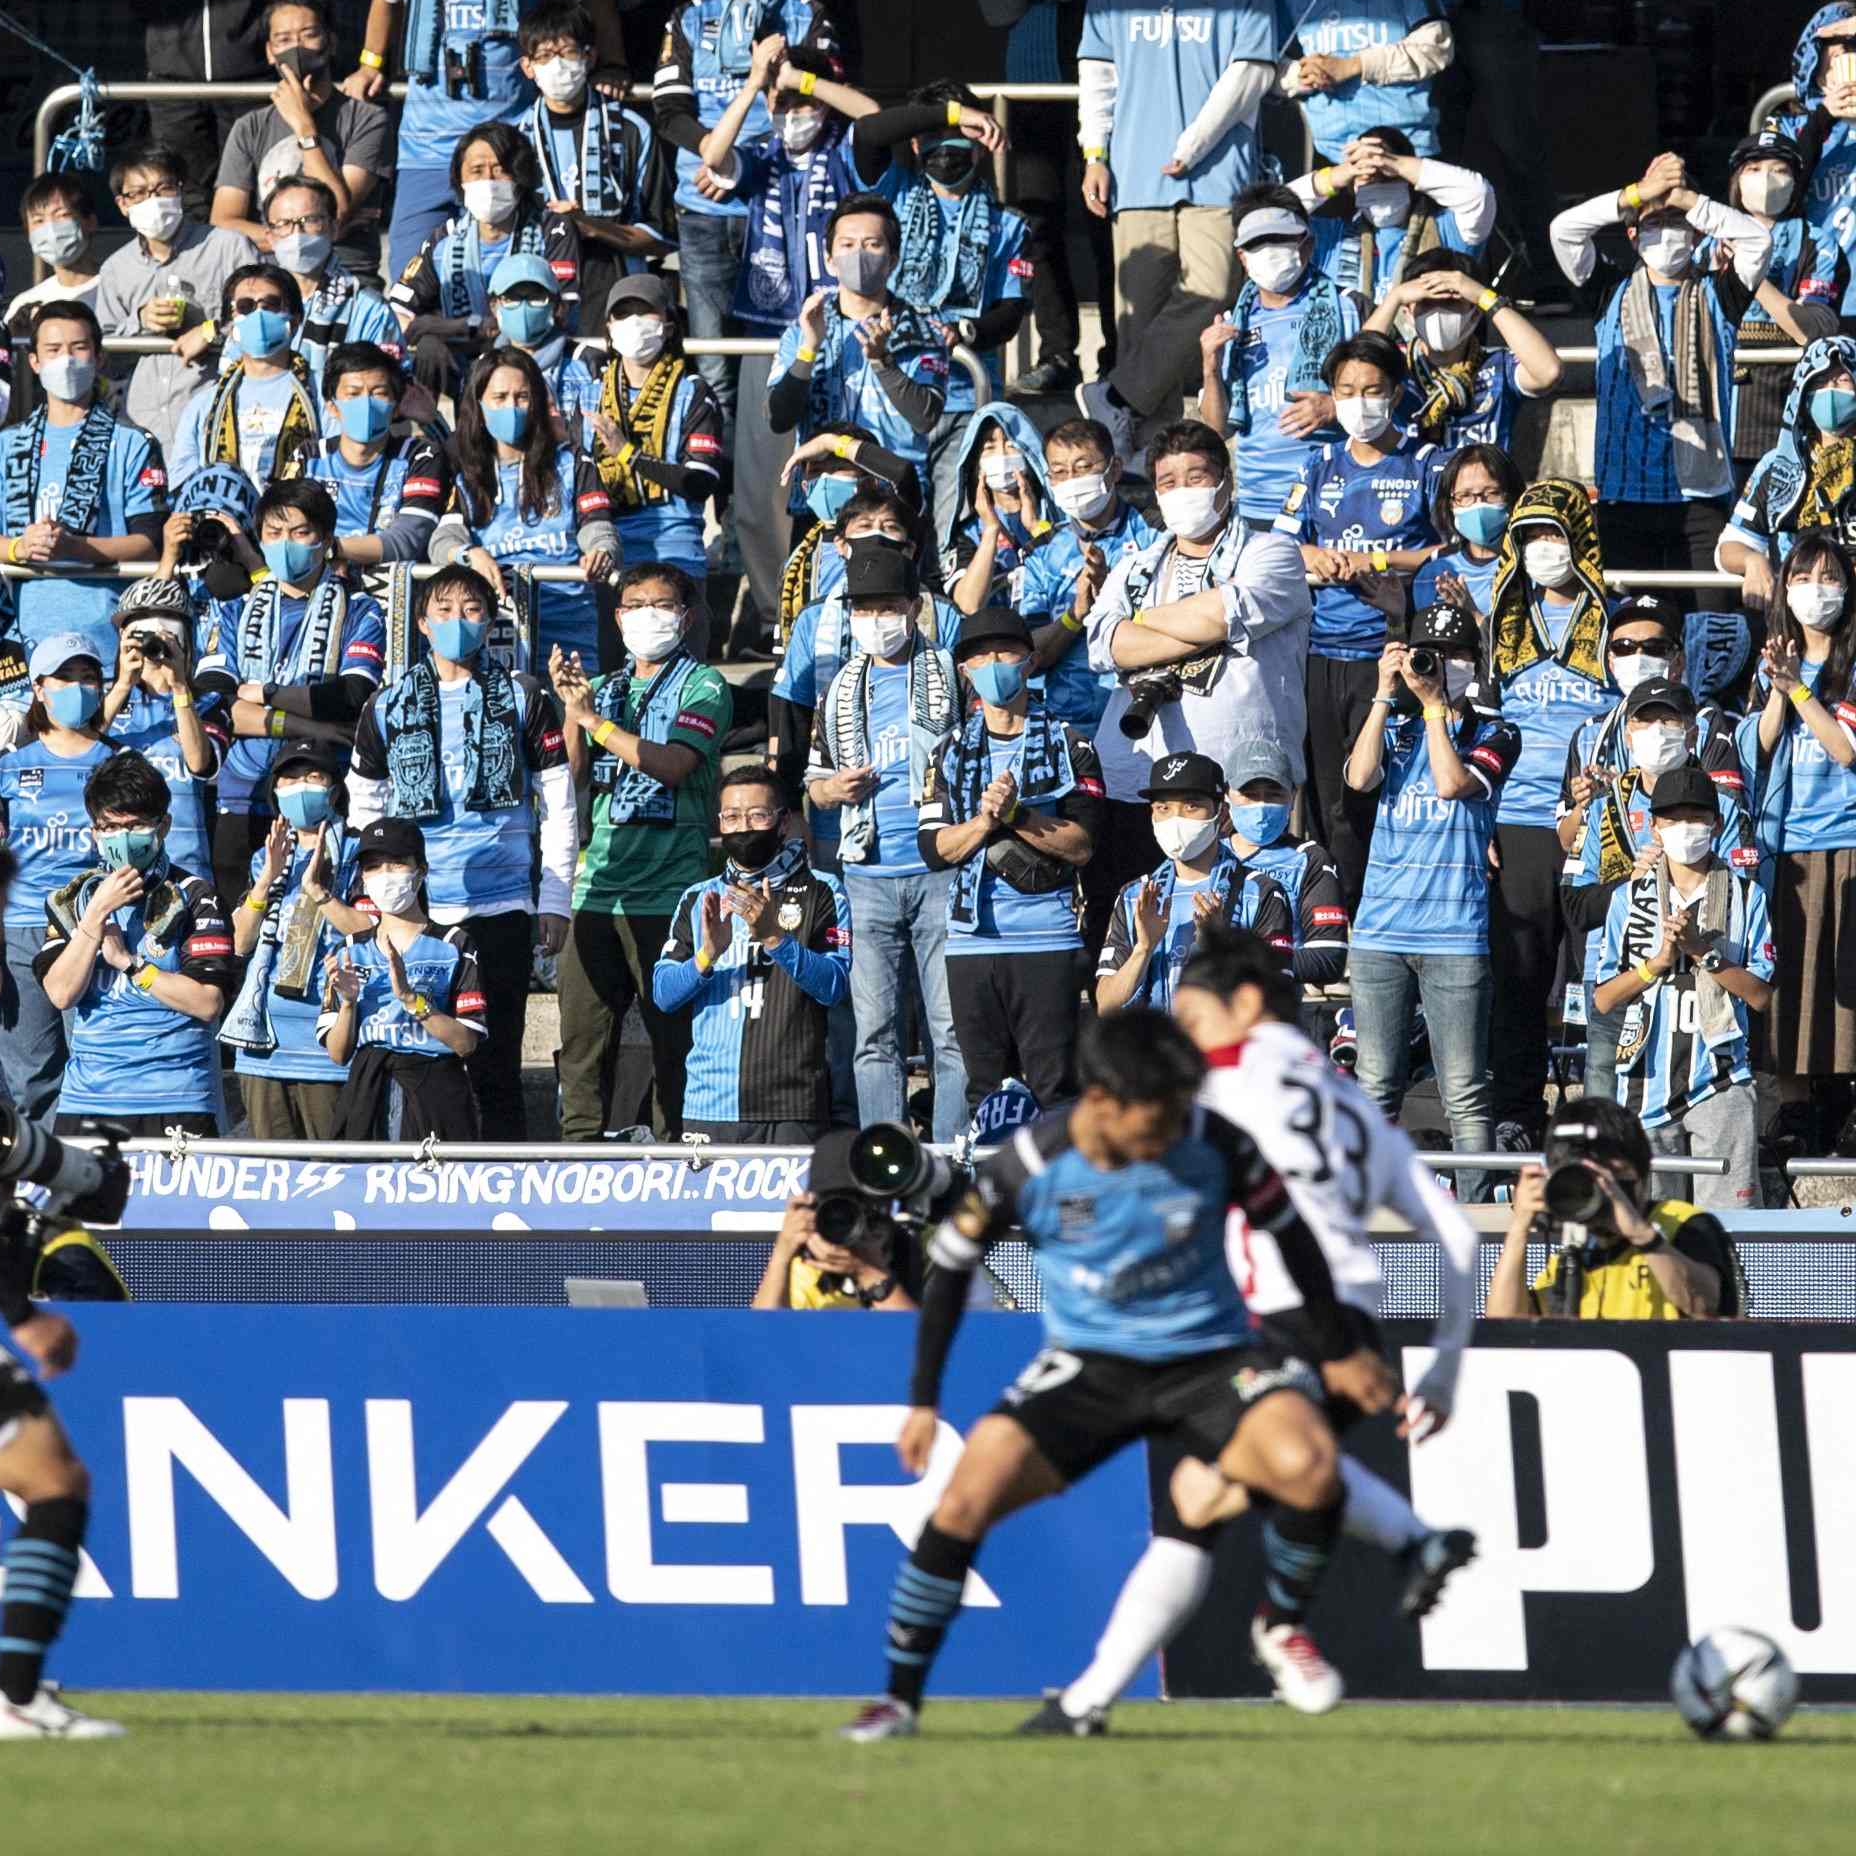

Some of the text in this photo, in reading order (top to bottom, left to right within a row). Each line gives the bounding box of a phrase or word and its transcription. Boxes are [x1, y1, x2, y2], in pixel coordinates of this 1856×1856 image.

[1129, 15, 1214, 47] FUJITSU
[1371, 479, 1421, 495] RENOSY
[1379, 794, 1453, 827] FUJITS
[22, 824, 95, 857] FUJITS
[717, 940, 775, 970] UJITS
[730, 978, 765, 1021] 14
[1668, 987, 1698, 1028] 10
[357, 1020, 431, 1048] UJITSU
[125, 1156, 294, 1202] HUNDER
[365, 1163, 513, 1206] RISING
